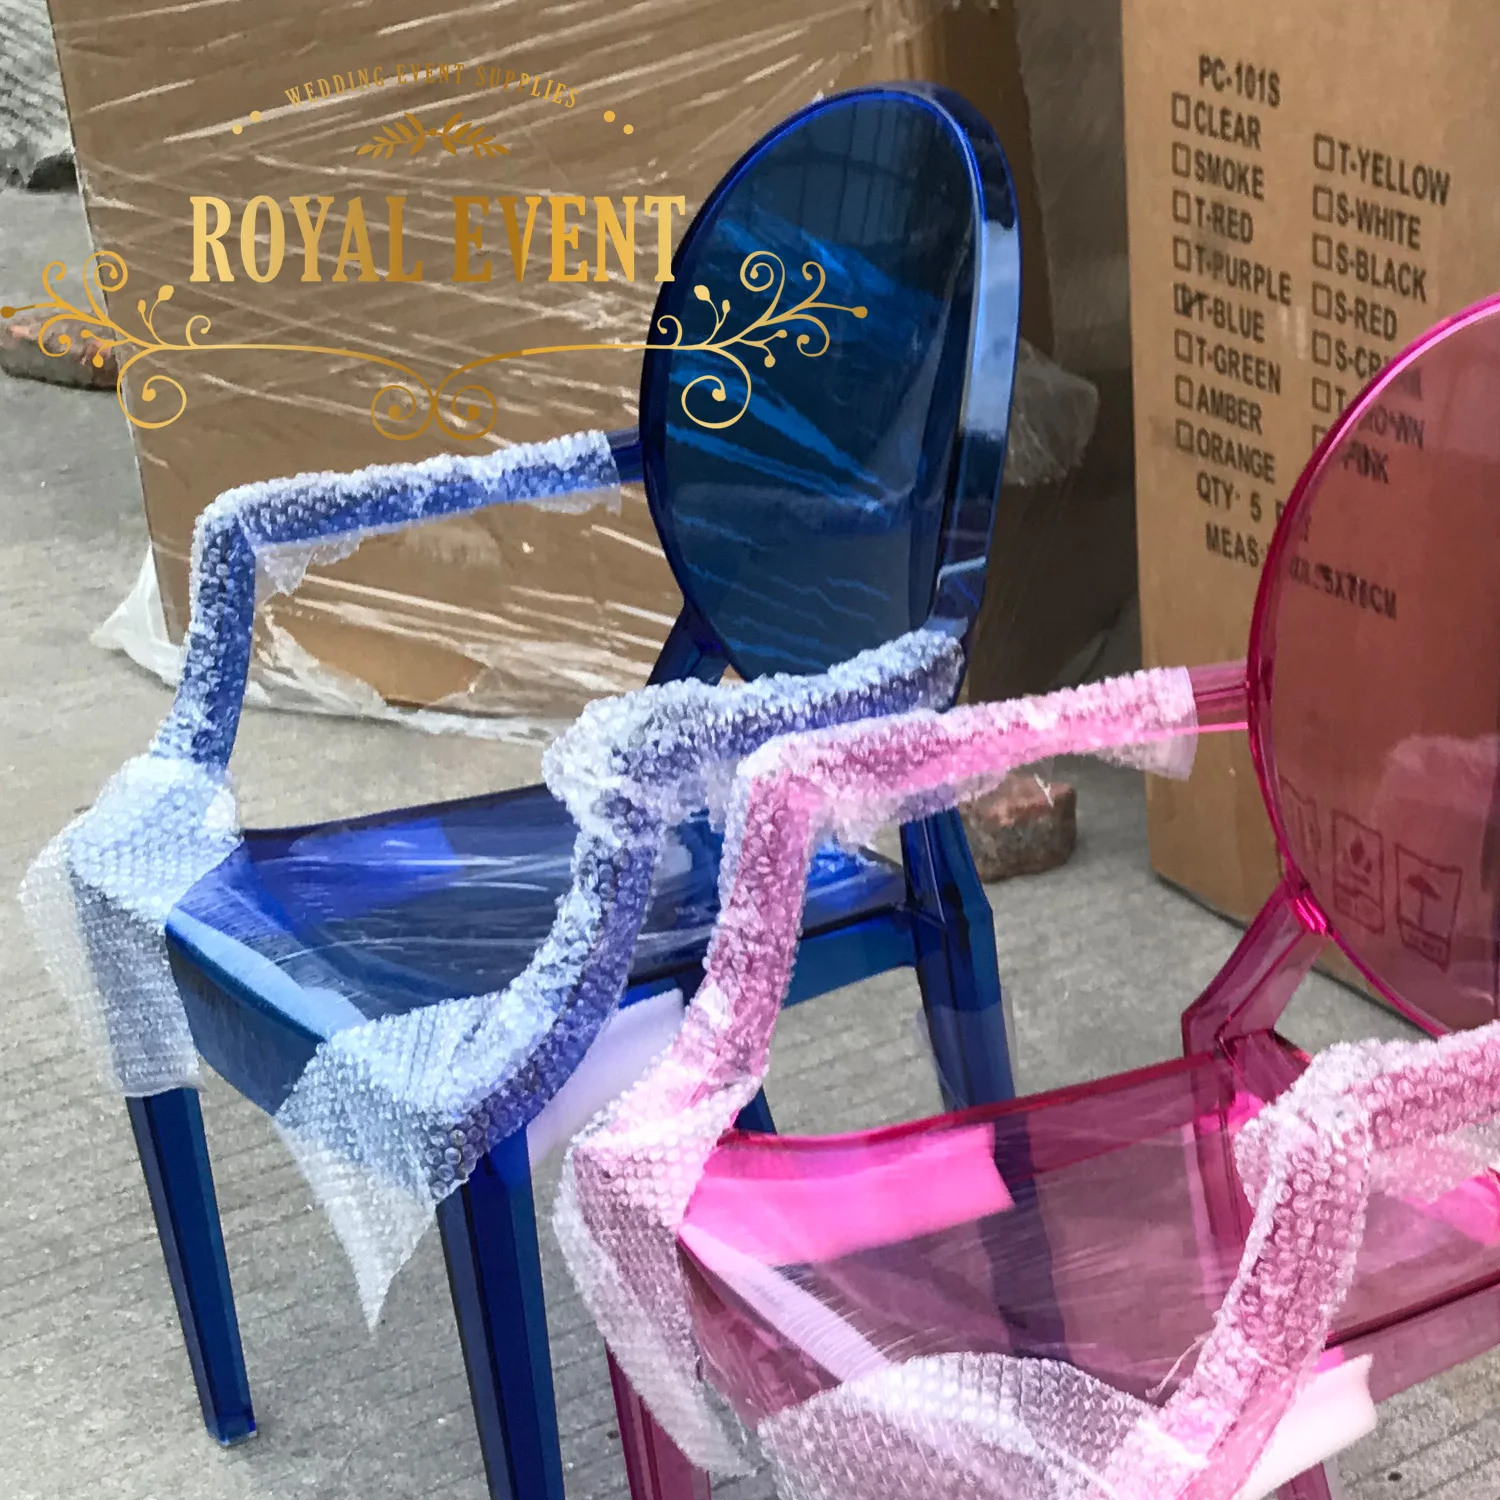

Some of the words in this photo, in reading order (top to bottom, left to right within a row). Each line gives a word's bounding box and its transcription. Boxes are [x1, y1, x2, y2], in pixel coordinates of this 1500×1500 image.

[1198, 54, 1282, 109] PC-101S
[1194, 100, 1261, 150] CLEAR
[1194, 148, 1265, 201] SMOKE
[1338, 141, 1450, 207] T-YELLOW
[1194, 197, 1254, 244] T-RED
[1336, 191, 1421, 252] S-WHITE
[1194, 245, 1292, 306] T-PURPLE
[1335, 240, 1427, 303] S-BLACK
[1194, 292, 1265, 343] T-BLUE
[1334, 289, 1398, 343] S-RED
[1195, 338, 1281, 396] T-GREEN
[1196, 384, 1263, 436] AMBER
[1197, 428, 1276, 485] ORANGE
